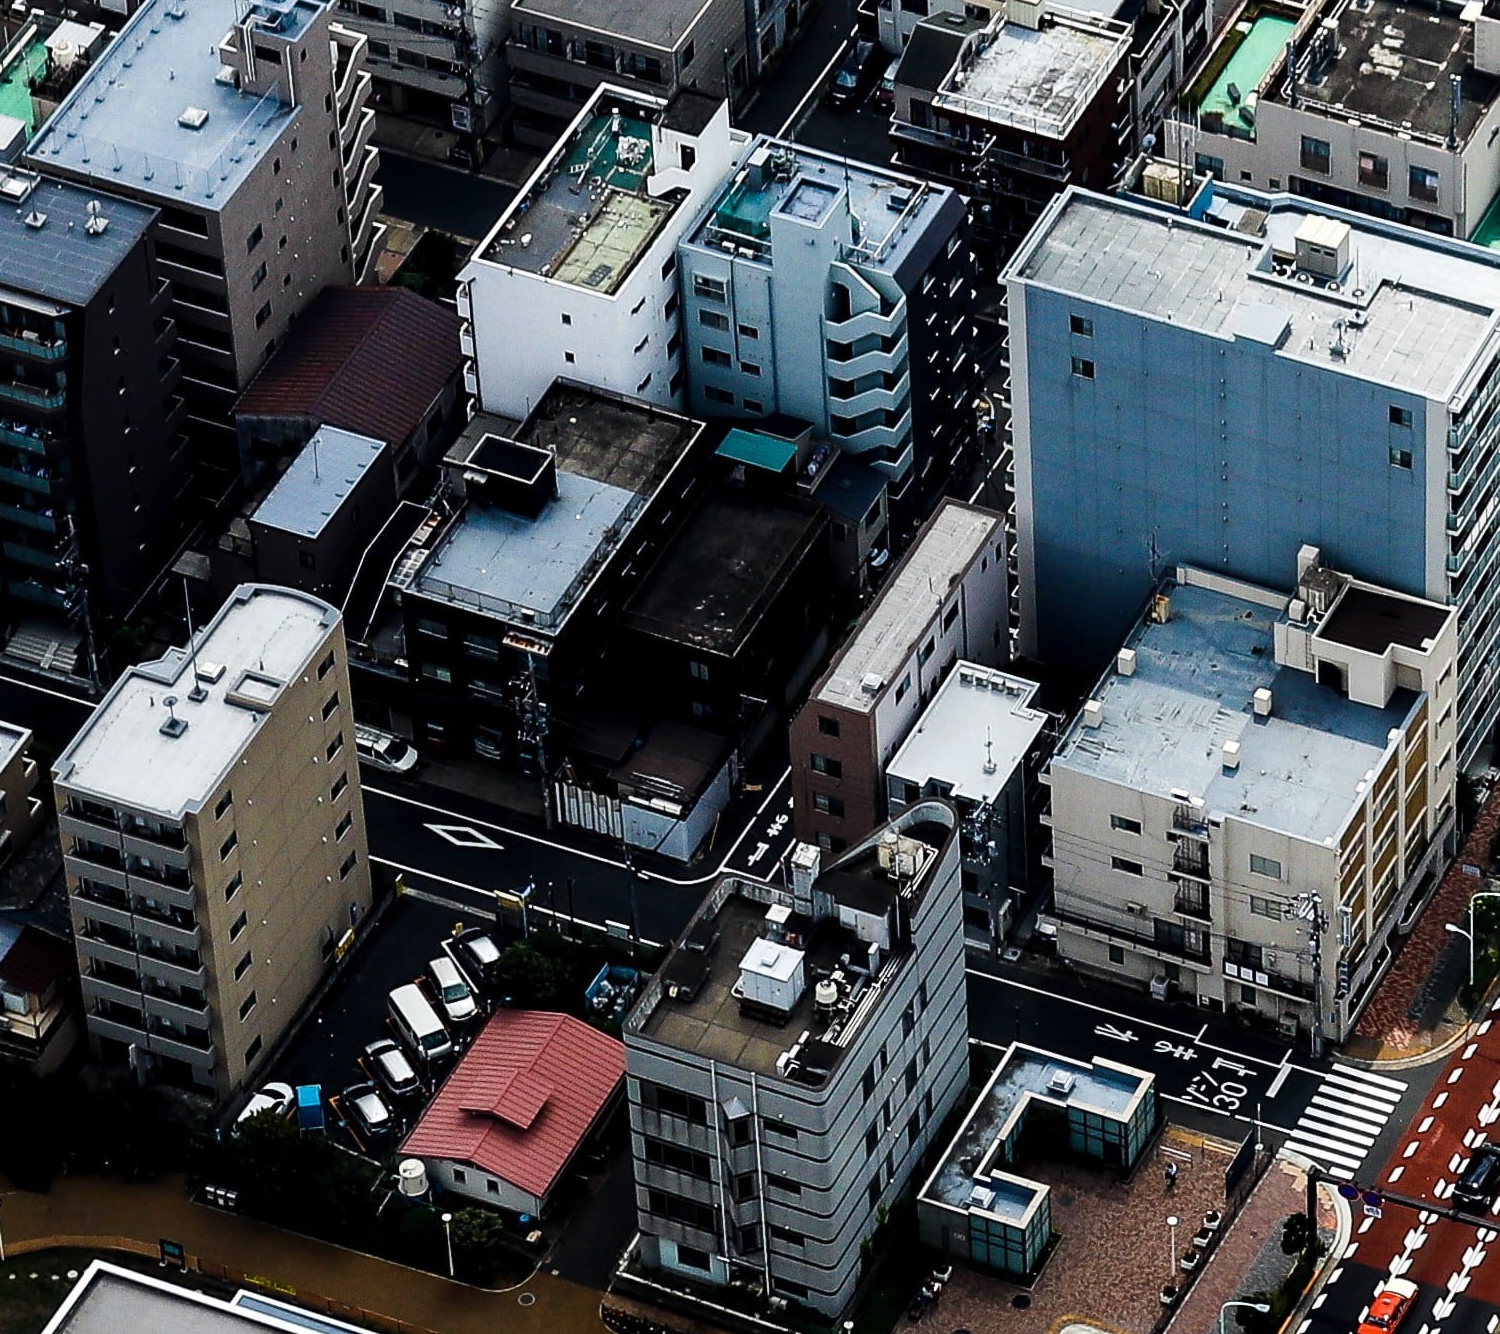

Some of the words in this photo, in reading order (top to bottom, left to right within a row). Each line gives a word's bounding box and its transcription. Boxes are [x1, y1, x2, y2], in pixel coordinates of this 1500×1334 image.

[1093, 1022, 1258, 1078] 止まれ
[1212, 1080, 1249, 1111] 30
